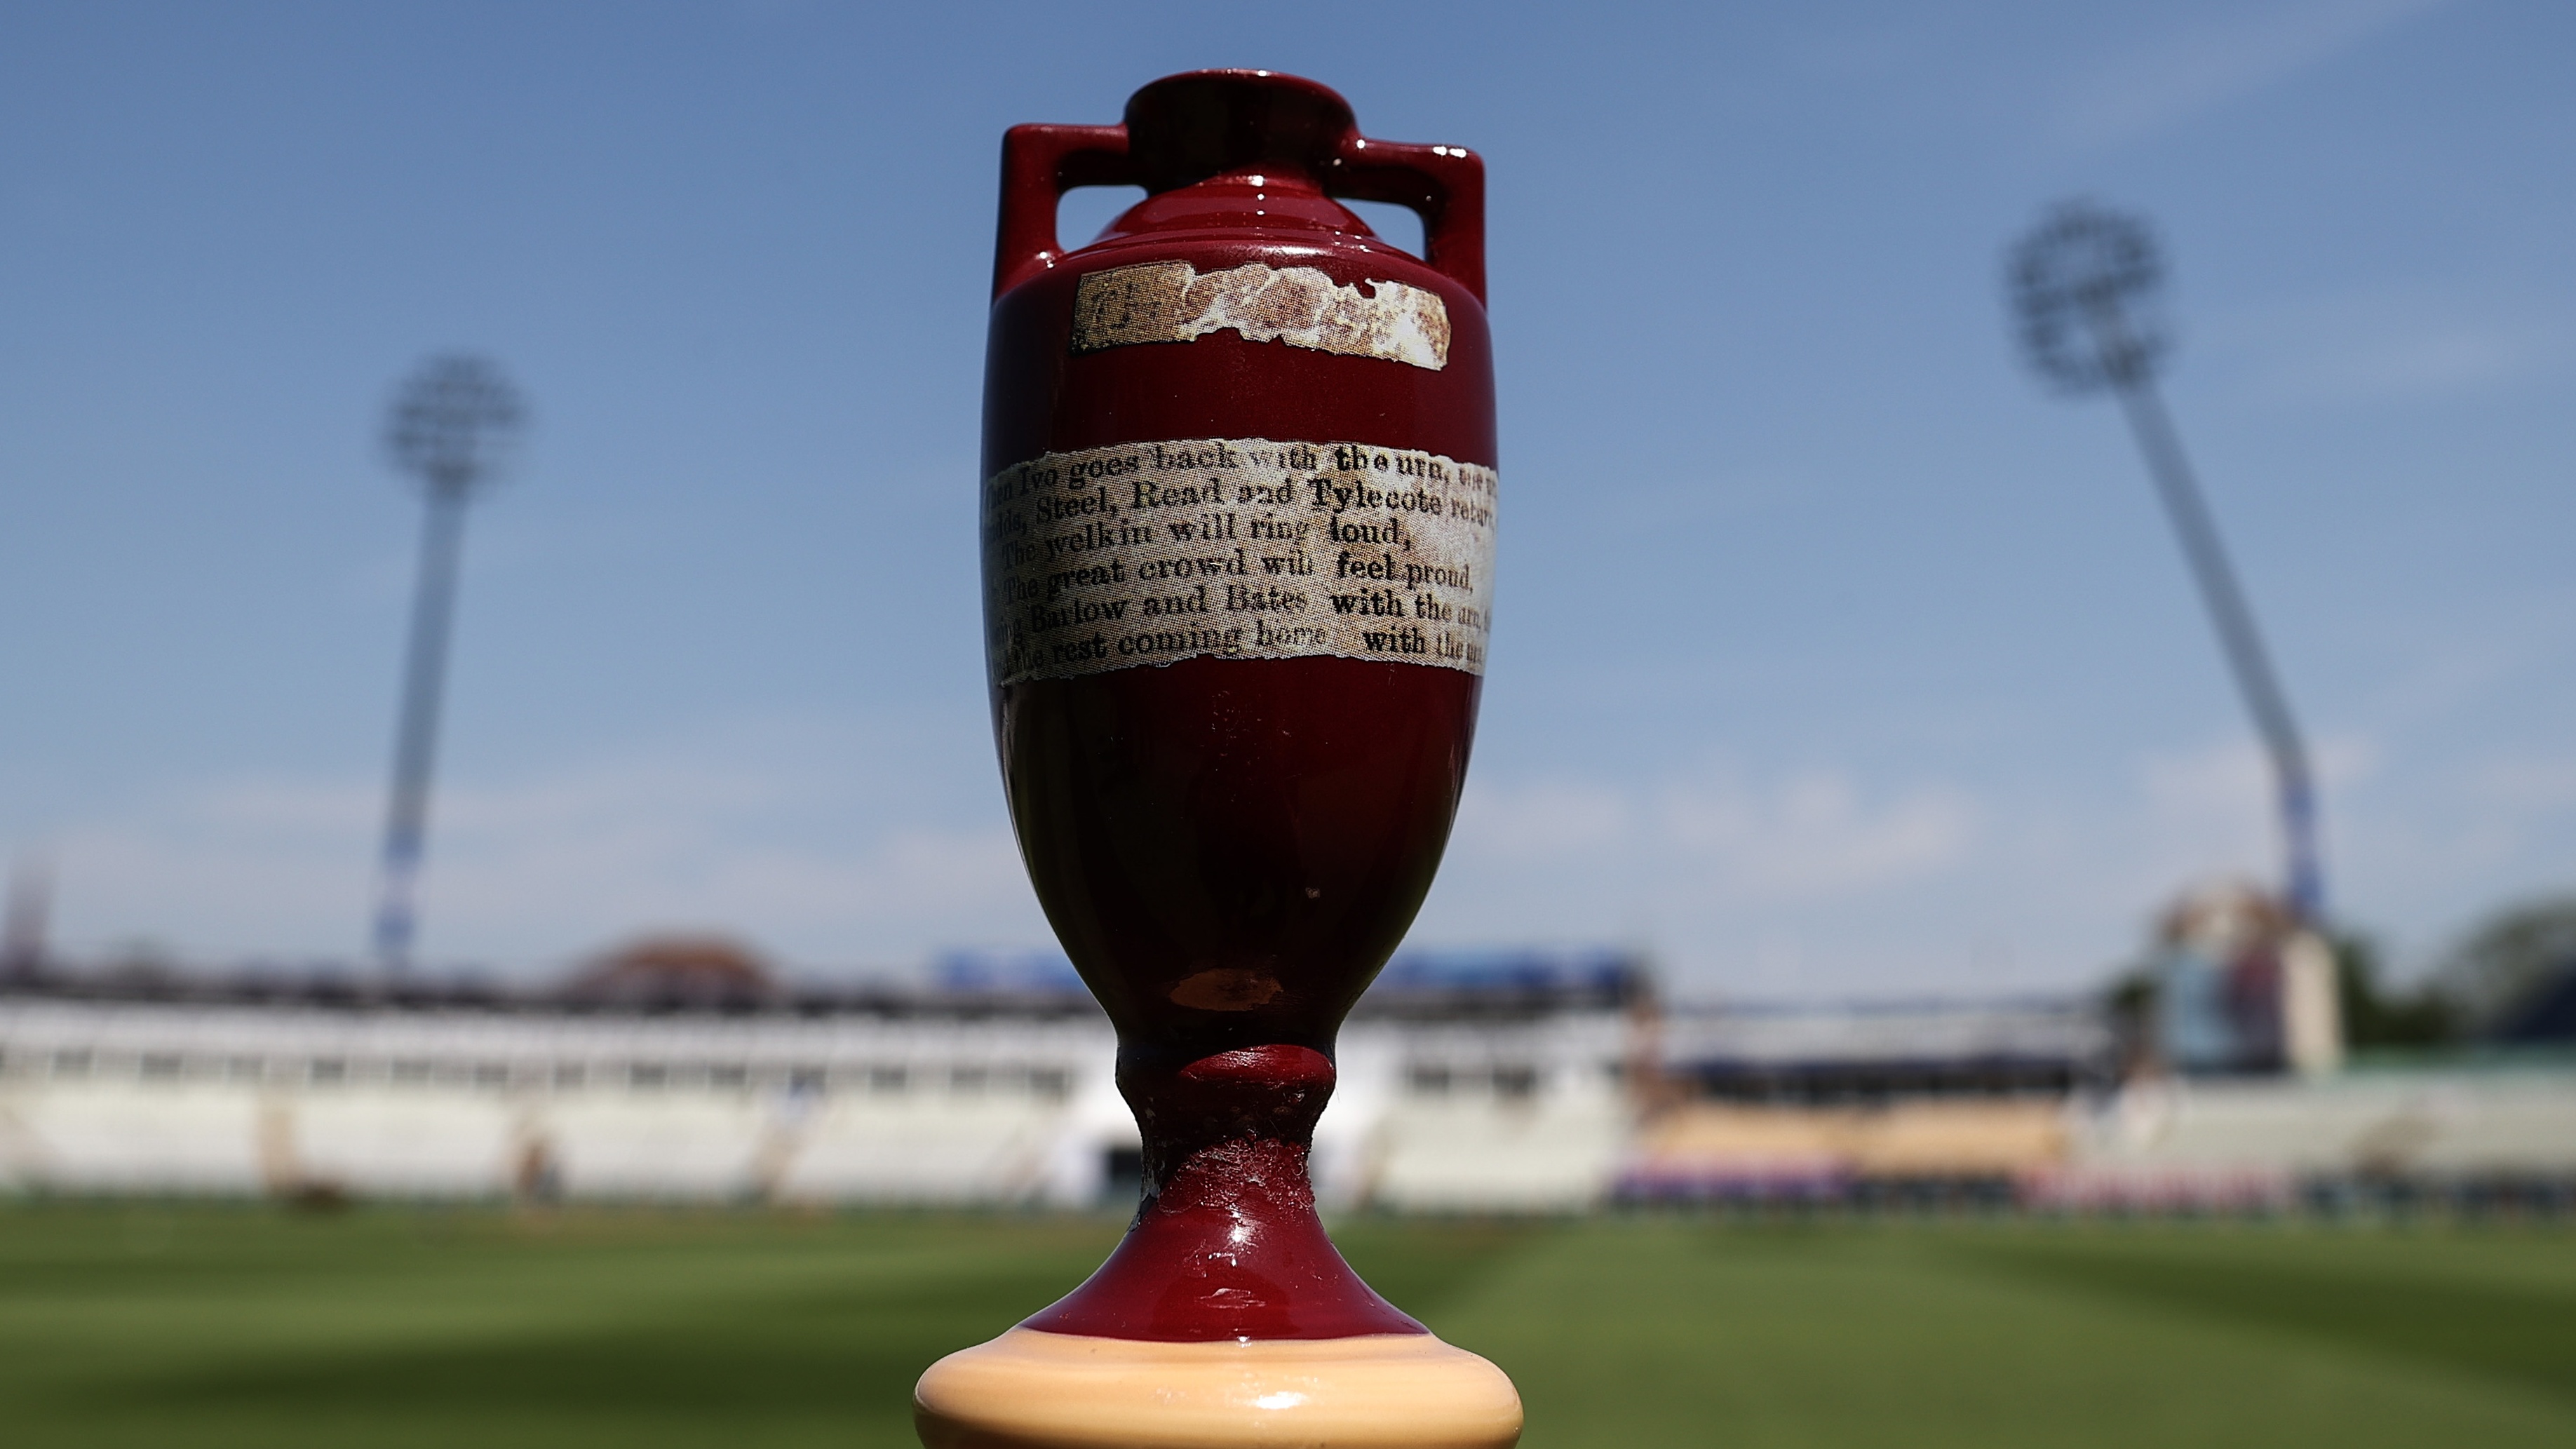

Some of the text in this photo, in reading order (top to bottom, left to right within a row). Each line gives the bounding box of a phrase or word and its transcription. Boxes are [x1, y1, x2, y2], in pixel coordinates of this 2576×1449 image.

[1020, 466, 1058, 494] Ivo
[1070, 457, 1139, 490] goes
[1154, 443, 1239, 470] back
[1250, 445, 1316, 470] with
[1335, 445, 1389, 472] the
[1397, 457, 1450, 483] urn,
[1037, 486, 1119, 523] Steel,
[1132, 478, 1224, 508] Read
[1237, 479, 1293, 504] and
[1309, 478, 1442, 515] Tylecote
[1002, 513, 1412, 570] The welkin will ring loud,
[1004, 577, 1038, 605] The
[1048, 560, 1125, 600] great
[1138, 548, 1248, 580] crowd
[1335, 550, 1395, 580] feel
[1406, 564, 1473, 593] proud,
[1031, 598, 1128, 632] Barlow
[1144, 586, 1208, 616] and
[1225, 584, 1308, 612] Bates
[1330, 588, 1403, 617] with
[1415, 593, 1452, 624] the
[1053, 633, 1106, 664] rest
[1119, 622, 1243, 655] coming
[1257, 619, 1326, 646] home
[1363, 626, 1427, 654] with
[1438, 631, 1463, 659] the
